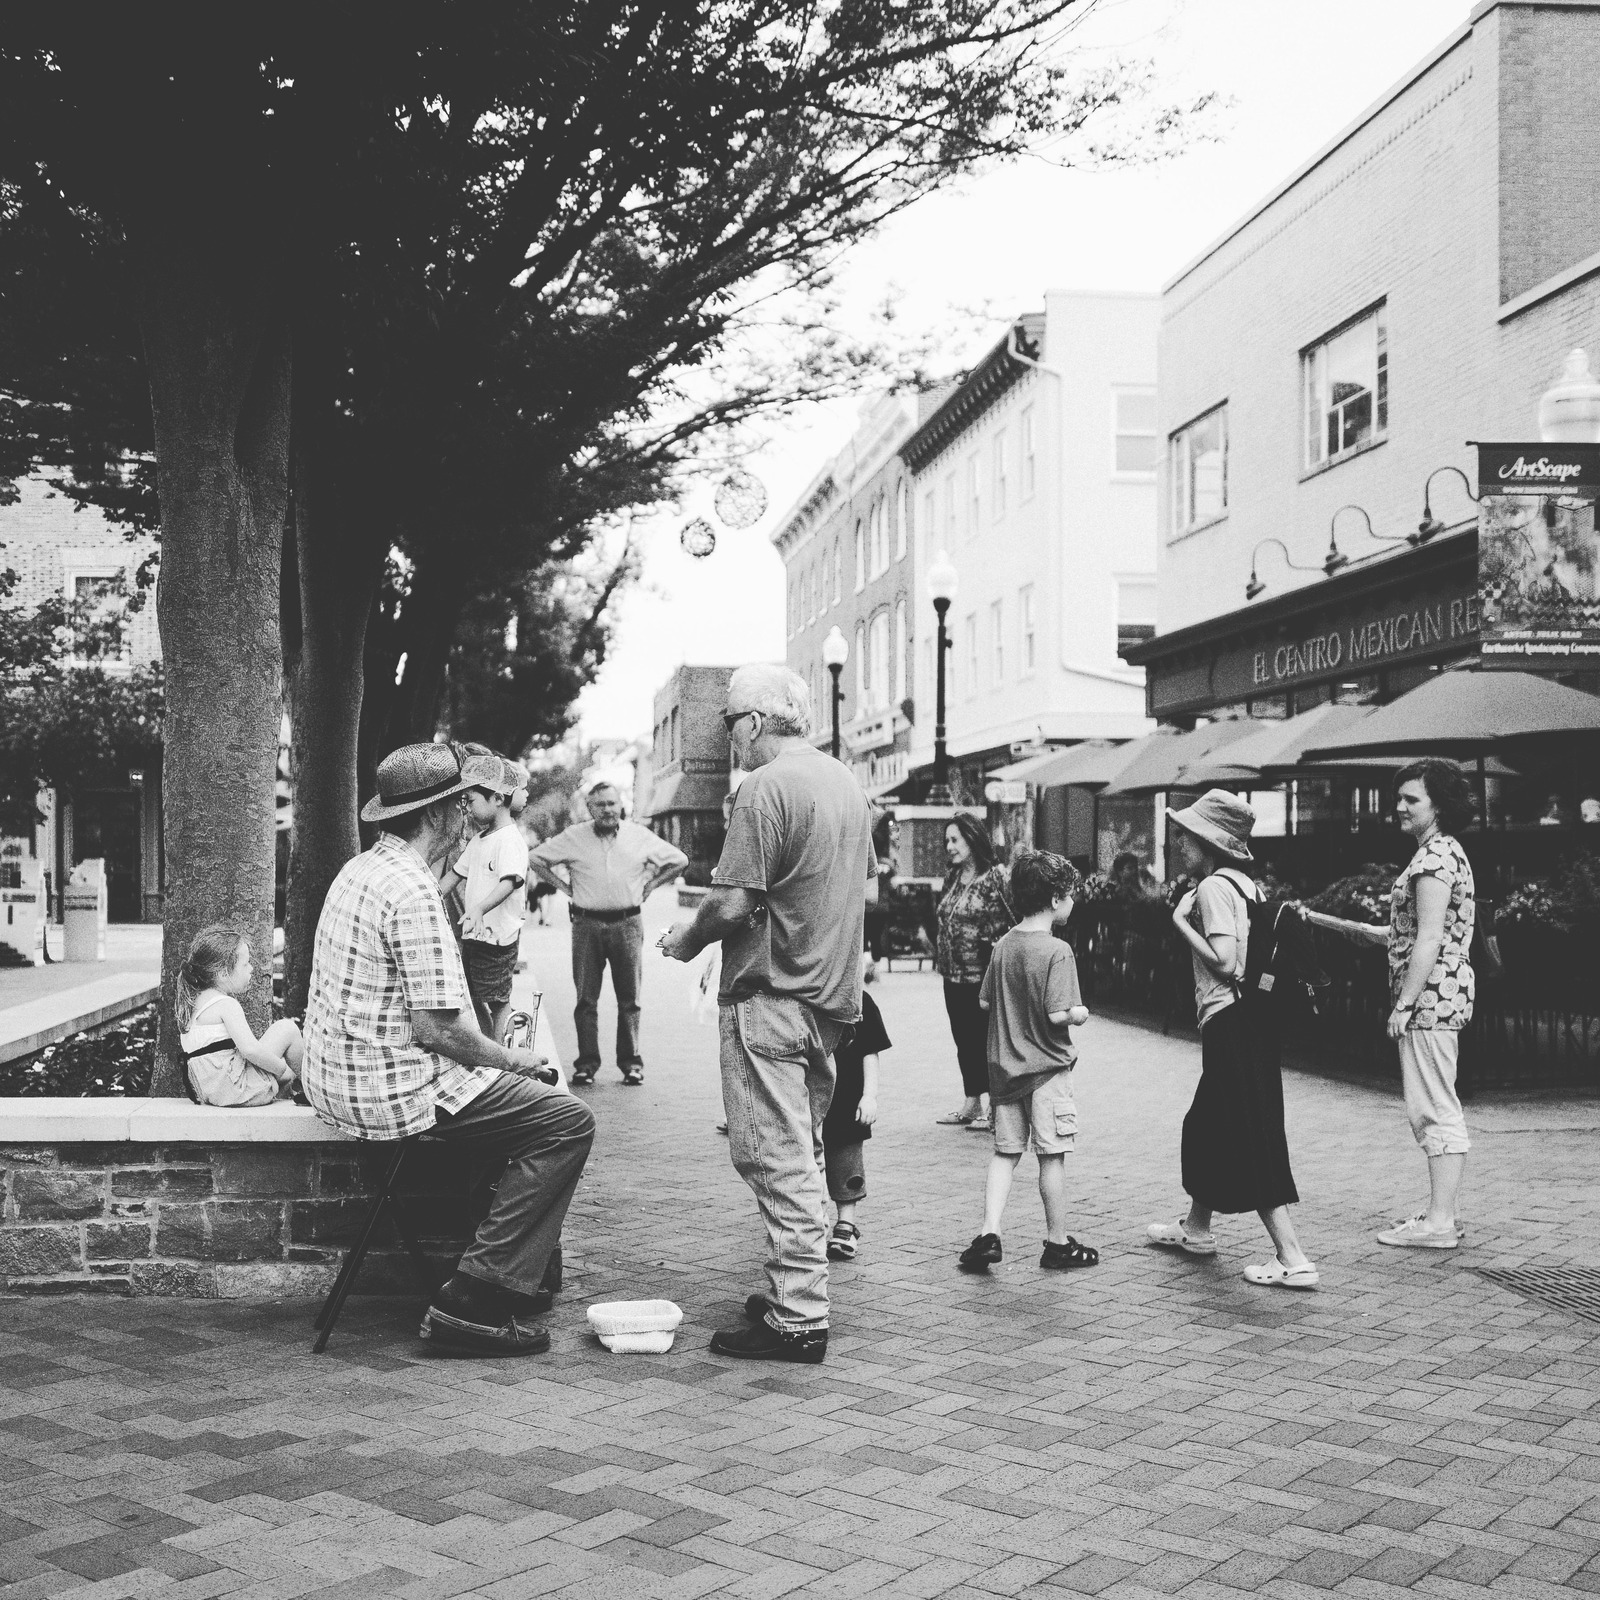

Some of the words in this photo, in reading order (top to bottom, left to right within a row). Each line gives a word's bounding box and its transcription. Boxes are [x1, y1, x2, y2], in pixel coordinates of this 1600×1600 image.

[1499, 457, 1582, 482] ArtScape
[1254, 652, 1270, 684] EL
[1274, 631, 1342, 679] CENTRO
[1349, 604, 1442, 662] MEXICAN
[1450, 594, 1482, 639] RE
